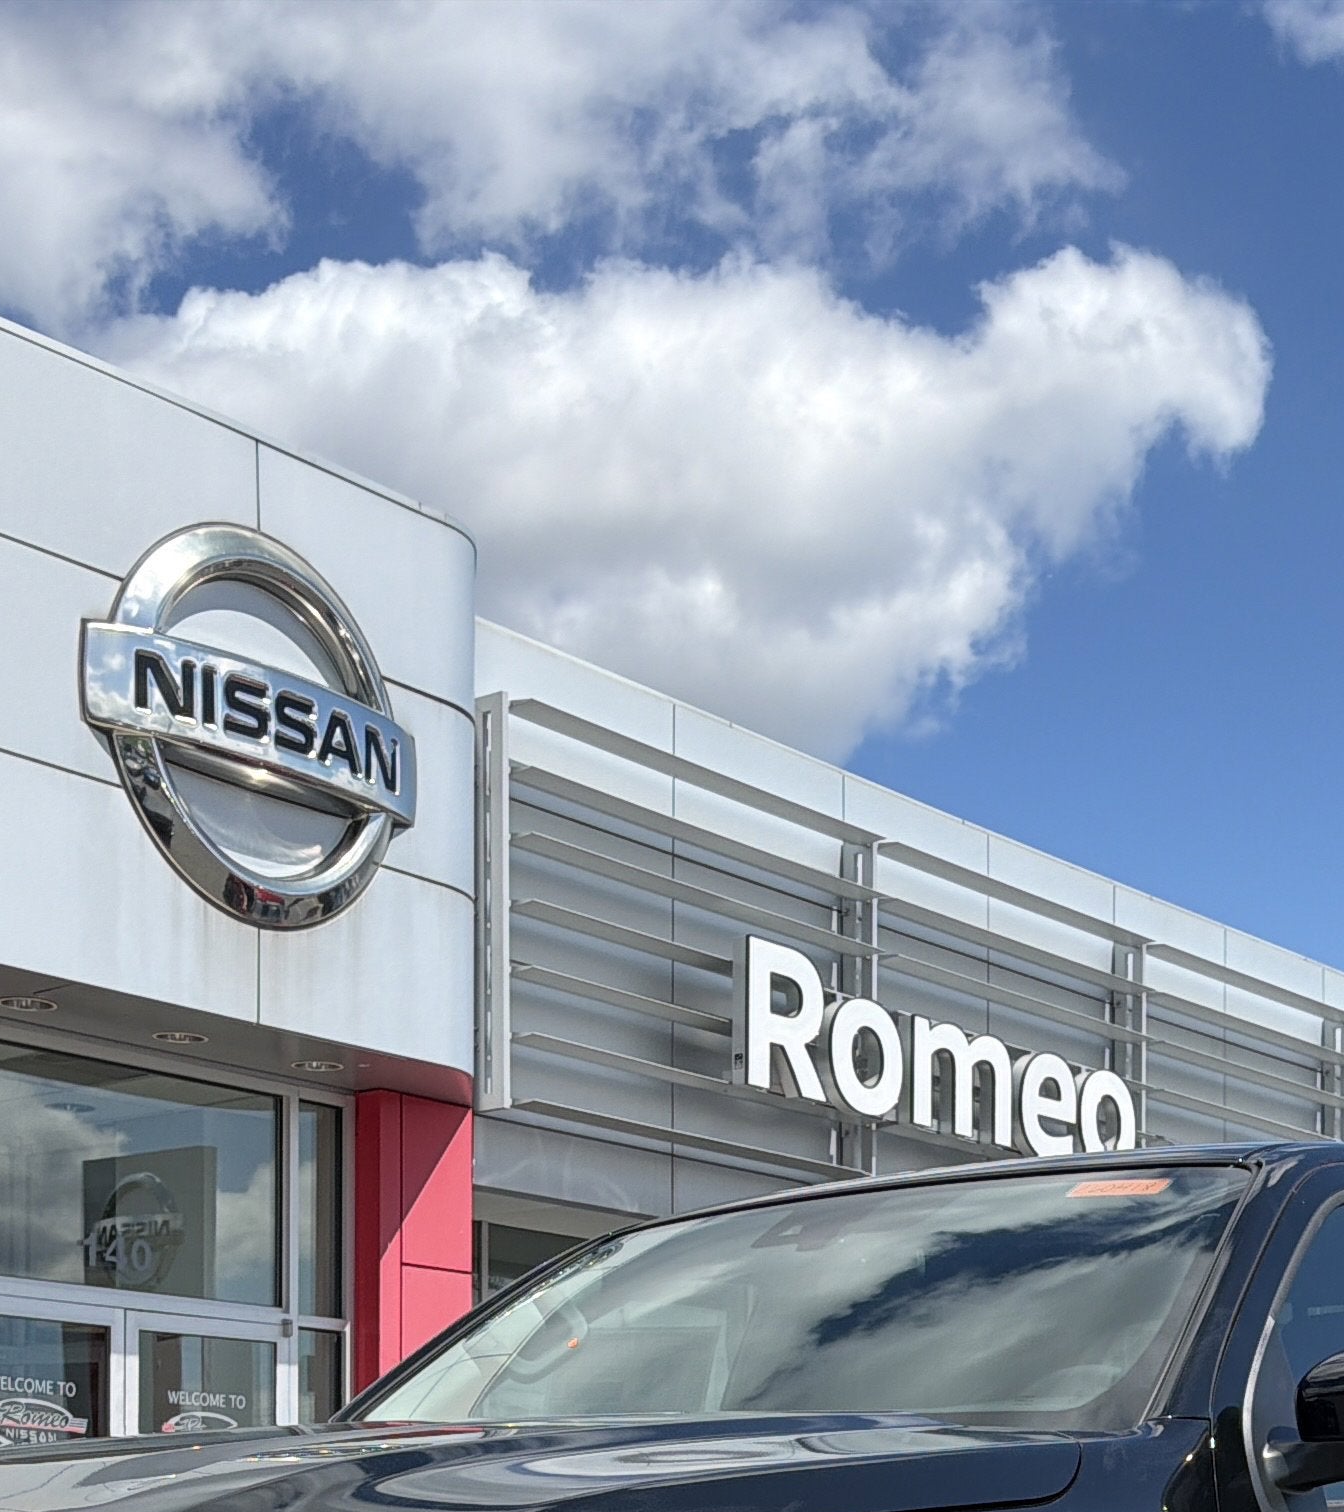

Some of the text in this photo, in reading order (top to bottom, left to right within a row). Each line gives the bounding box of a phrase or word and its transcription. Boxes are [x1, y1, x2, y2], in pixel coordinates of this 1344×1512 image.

[134, 648, 402, 796] NISSAN
[739, 933, 1137, 1157] Romeo
[82, 1231, 153, 1273] 140
[57, 1381, 77, 1398] TO
[167, 1389, 247, 1410] WELCOME TO
